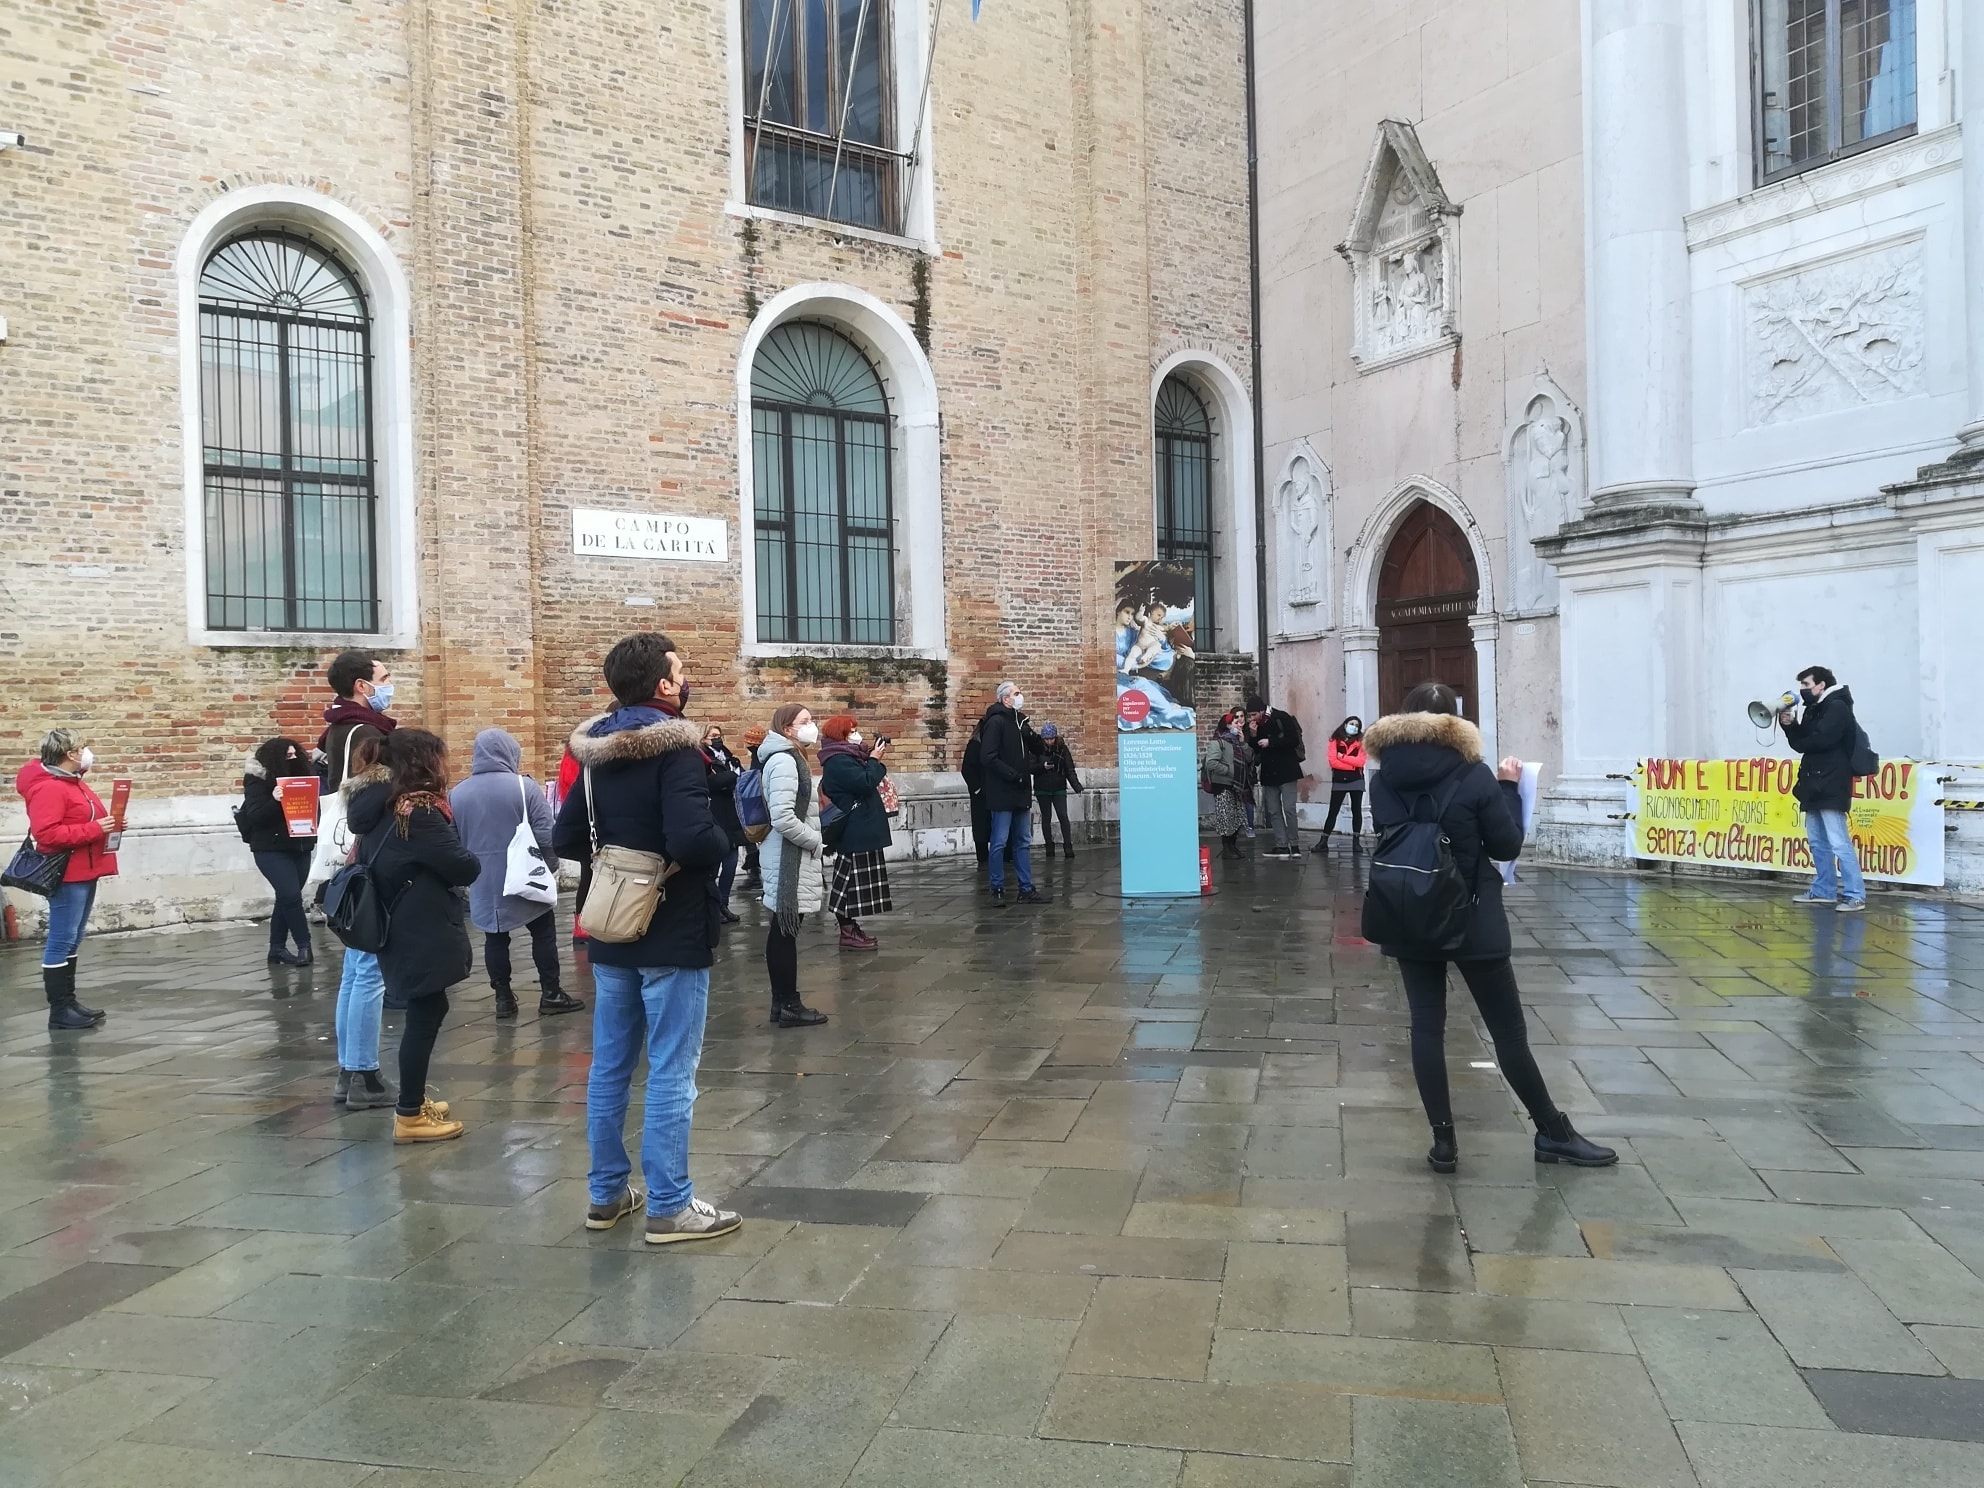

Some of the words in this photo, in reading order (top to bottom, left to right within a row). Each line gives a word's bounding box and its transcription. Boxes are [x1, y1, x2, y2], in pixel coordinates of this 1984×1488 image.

[615, 517, 689, 535] CAMPO
[582, 533, 606, 548] DE
[615, 536, 636, 550] LA
[1646, 757, 1686, 791] NON
[1724, 757, 1794, 795] TEMPO
[1851, 762, 1913, 800] ERO!
[1646, 795, 1721, 821] RICONOSCIMENTO
[1732, 799, 1770, 825] RISORSE
[1646, 826, 1697, 857] senza
[1703, 822, 1775, 864] cultura
